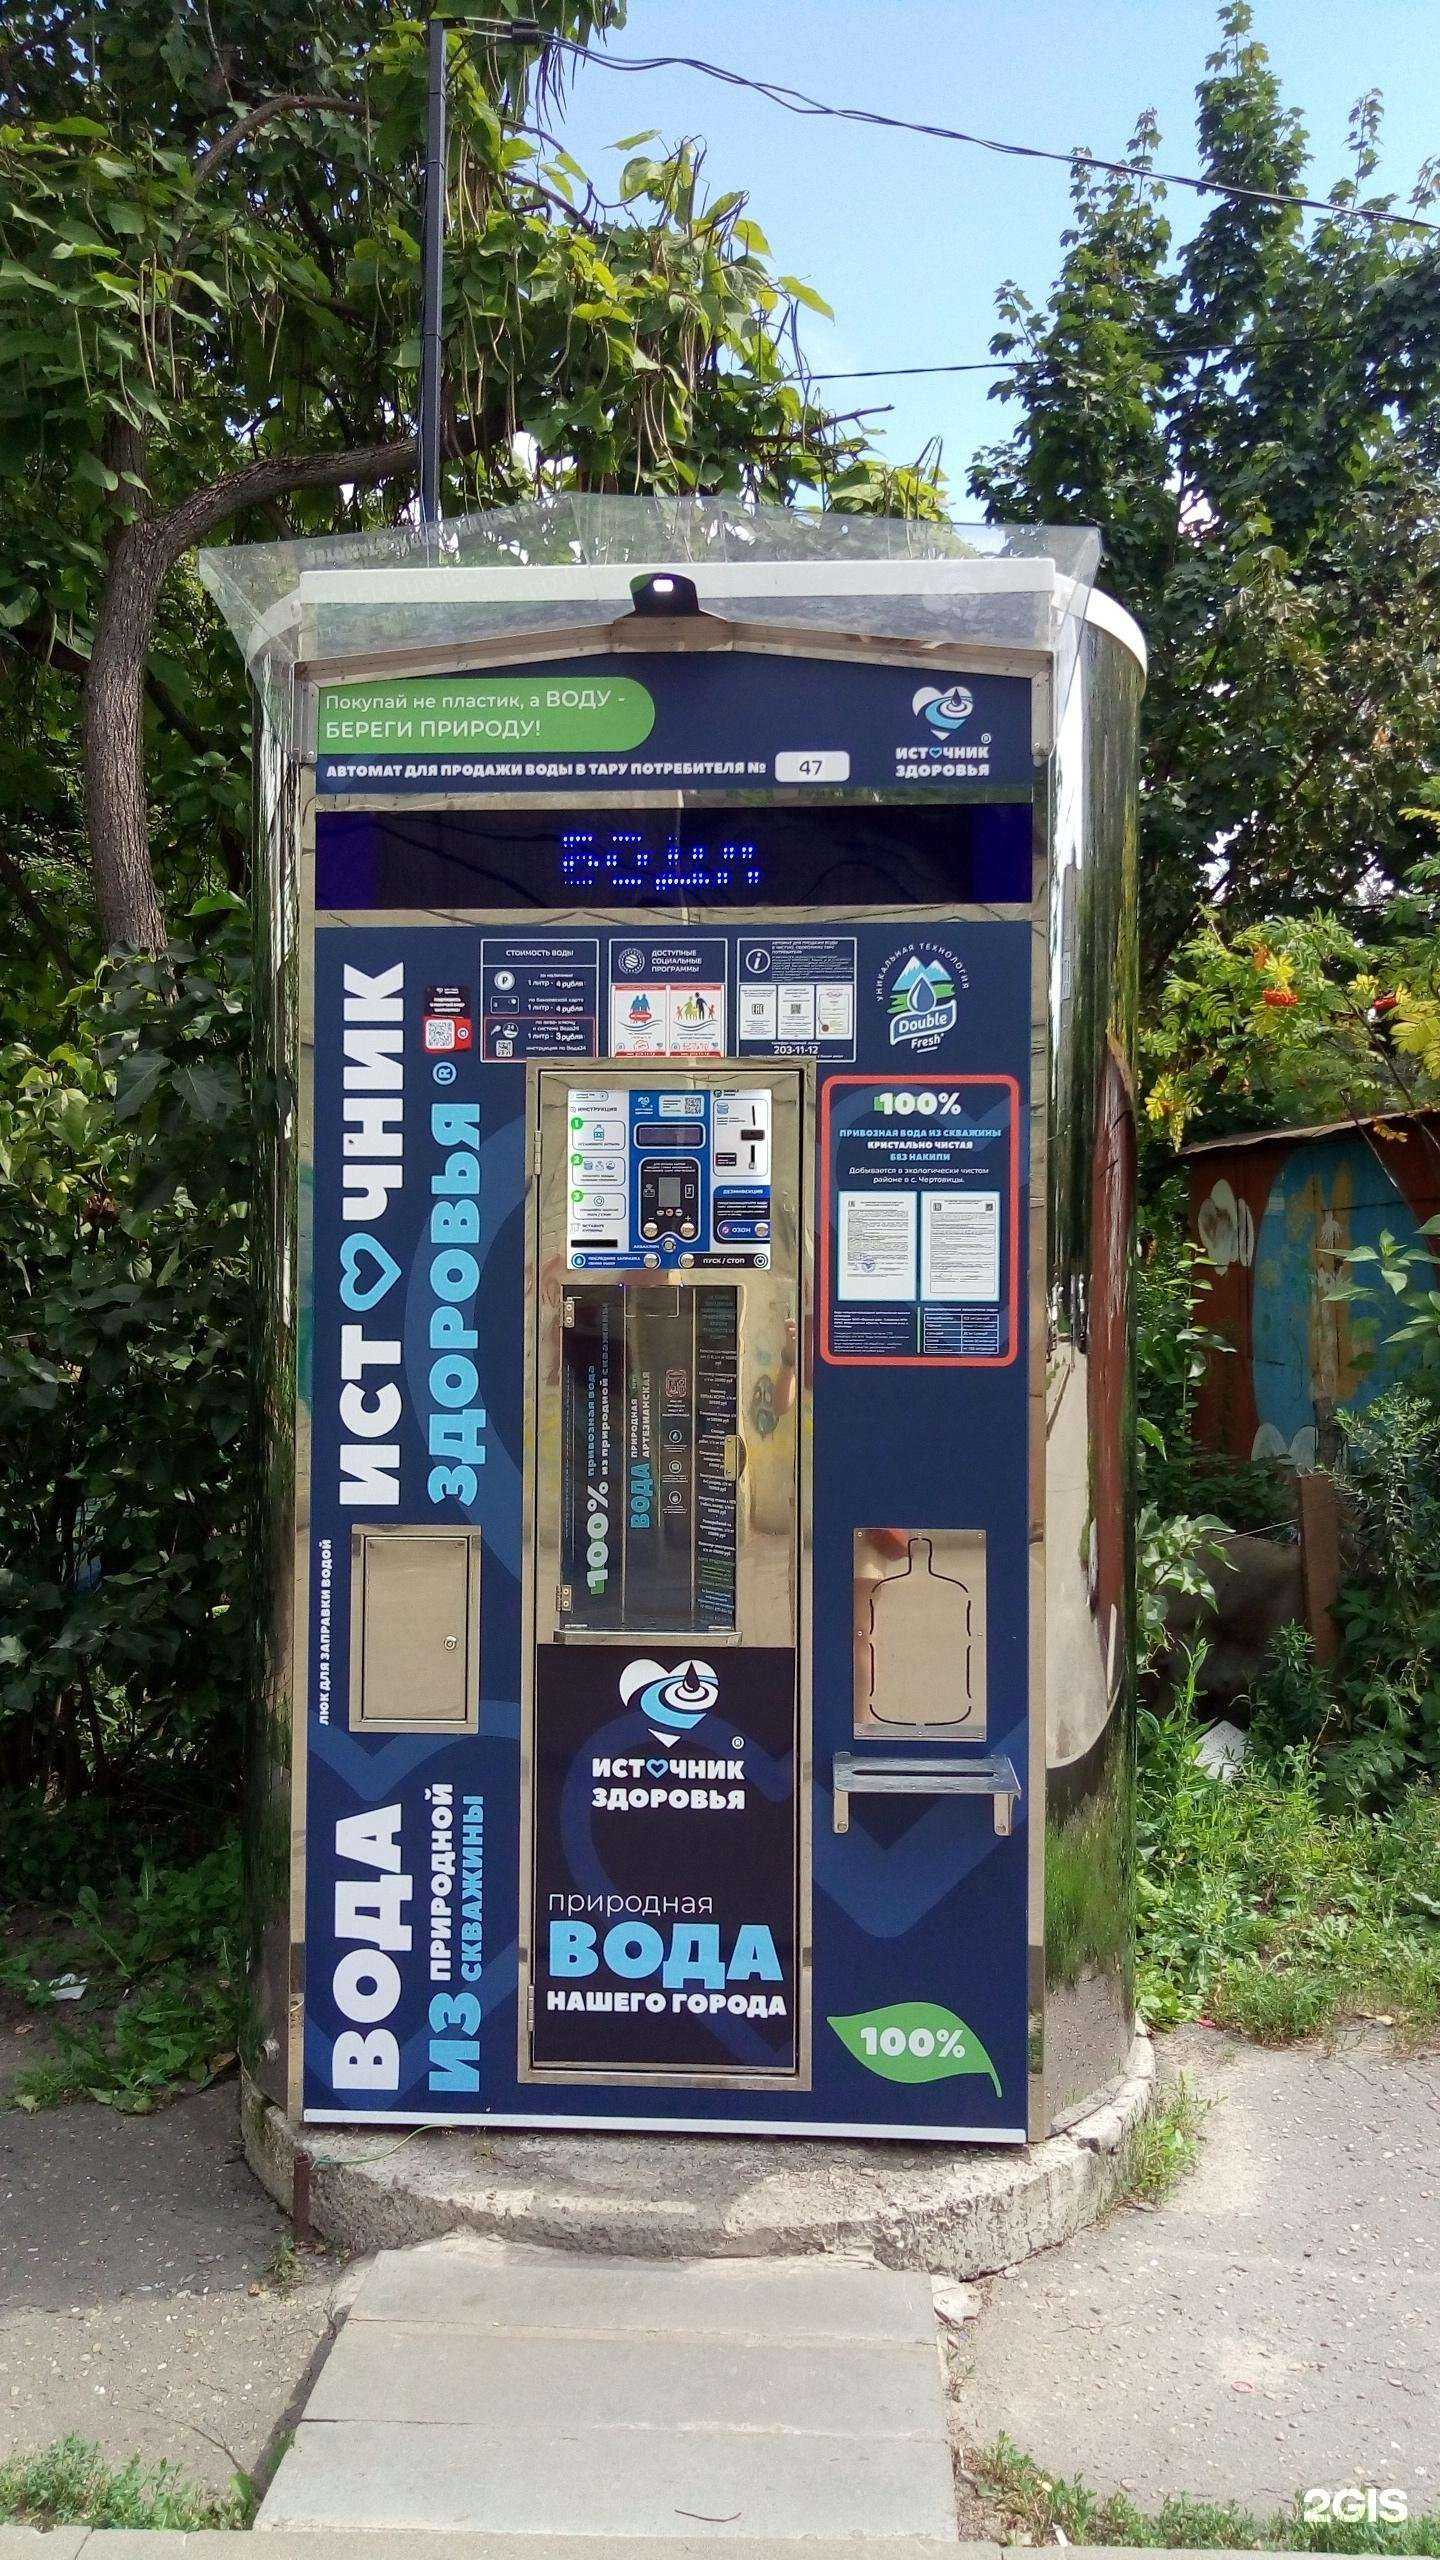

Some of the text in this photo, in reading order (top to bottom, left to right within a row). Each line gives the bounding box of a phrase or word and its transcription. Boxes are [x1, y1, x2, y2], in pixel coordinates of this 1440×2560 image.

[326, 693, 407, 713] Покупай
[413, 697, 436, 710] не
[442, 695, 524, 711] пластик,
[530, 695, 541, 708] а
[546, 690, 612, 710] ВОДУ
[326, 719, 542, 740] БЕРЕГИ ПРИРОДУ!
[326, 764, 403, 778] АВТОМАТ
[404, 764, 438, 779] ДЛЯ
[440, 764, 523, 778] ПРОДАЖИ
[525, 763, 574, 778] ВОДЫ
[575, 764, 586, 777] В
[587, 763, 628, 777] ТАРУ
[630, 762, 745, 777] ПОТРЕБИТЕЛЯ
[798, 759, 824, 777] 47
[895, 763, 991, 780] ЗДОРОВЬЯ
[506, 949, 574, 957] СТОИМОСТЬ ВОДЫ
[651, 949, 697, 958] ДОСТУПНЫЕ
[651, 957, 703, 966] СОЦИАЛЬНЫЕ
[651, 965, 700, 973] ПРОГРАММЫ
[876, 944, 915, 1003] УНИКАЛЬНАЯ
[918, 942, 970, 990] ТЕХНОЛОГИЯ
[899, 1013, 948, 1033] Double
[555, 1032, 561, 1040] 3
[911, 1034, 942, 1050] Fresh
[773, 1045, 819, 1055] 203-11-12
[878, 1091, 962, 1116] 100%
[839, 1128, 1002, 1138] ПРИВОЗНАЯ ВОДА ИЗ СКВАЖИНЫ
[867, 1141, 973, 1150] КРИСТАЛЬНО ЧИСТАЯ
[890, 1153, 951, 1162] БЕЗ НАКИПИ
[873, 1175, 903, 1184] районе
[960, 1167, 989, 1175] чистом
[427, 1102, 487, 1507] ЗДОРОВЬЯ
[587, 1365, 597, 1477] привозная вода
[599, 1377, 611, 1457] природной
[641, 1371, 651, 1458] АРТЕЗИАНСКАЯ
[630, 1398, 640, 1458] ПРИРОДНАЯ
[601, 1458, 609, 1476] из
[630, 1462, 653, 1529] ВОДА
[585, 1481, 610, 1589] 100%
[318, 1539, 332, 1726] ЛЮК ДЛЯ ЗАПРАВКИ ВОДОЙ
[591, 1787, 746, 1812] ЗДОРОВЬЯ
[425, 1783, 456, 1982] ПРИРОДНОЙ
[461, 1795, 485, 1983] СКВАЖИНЫ
[548, 1892, 713, 1919] природная
[332, 1803, 413, 2091] ВОДА
[549, 1920, 784, 1990] ВОДА
[547, 1990, 788, 2019] НАШЕГО ГОРОДА
[428, 1992, 482, 2093] ИЗ
[860, 2027, 966, 2060] 100%
